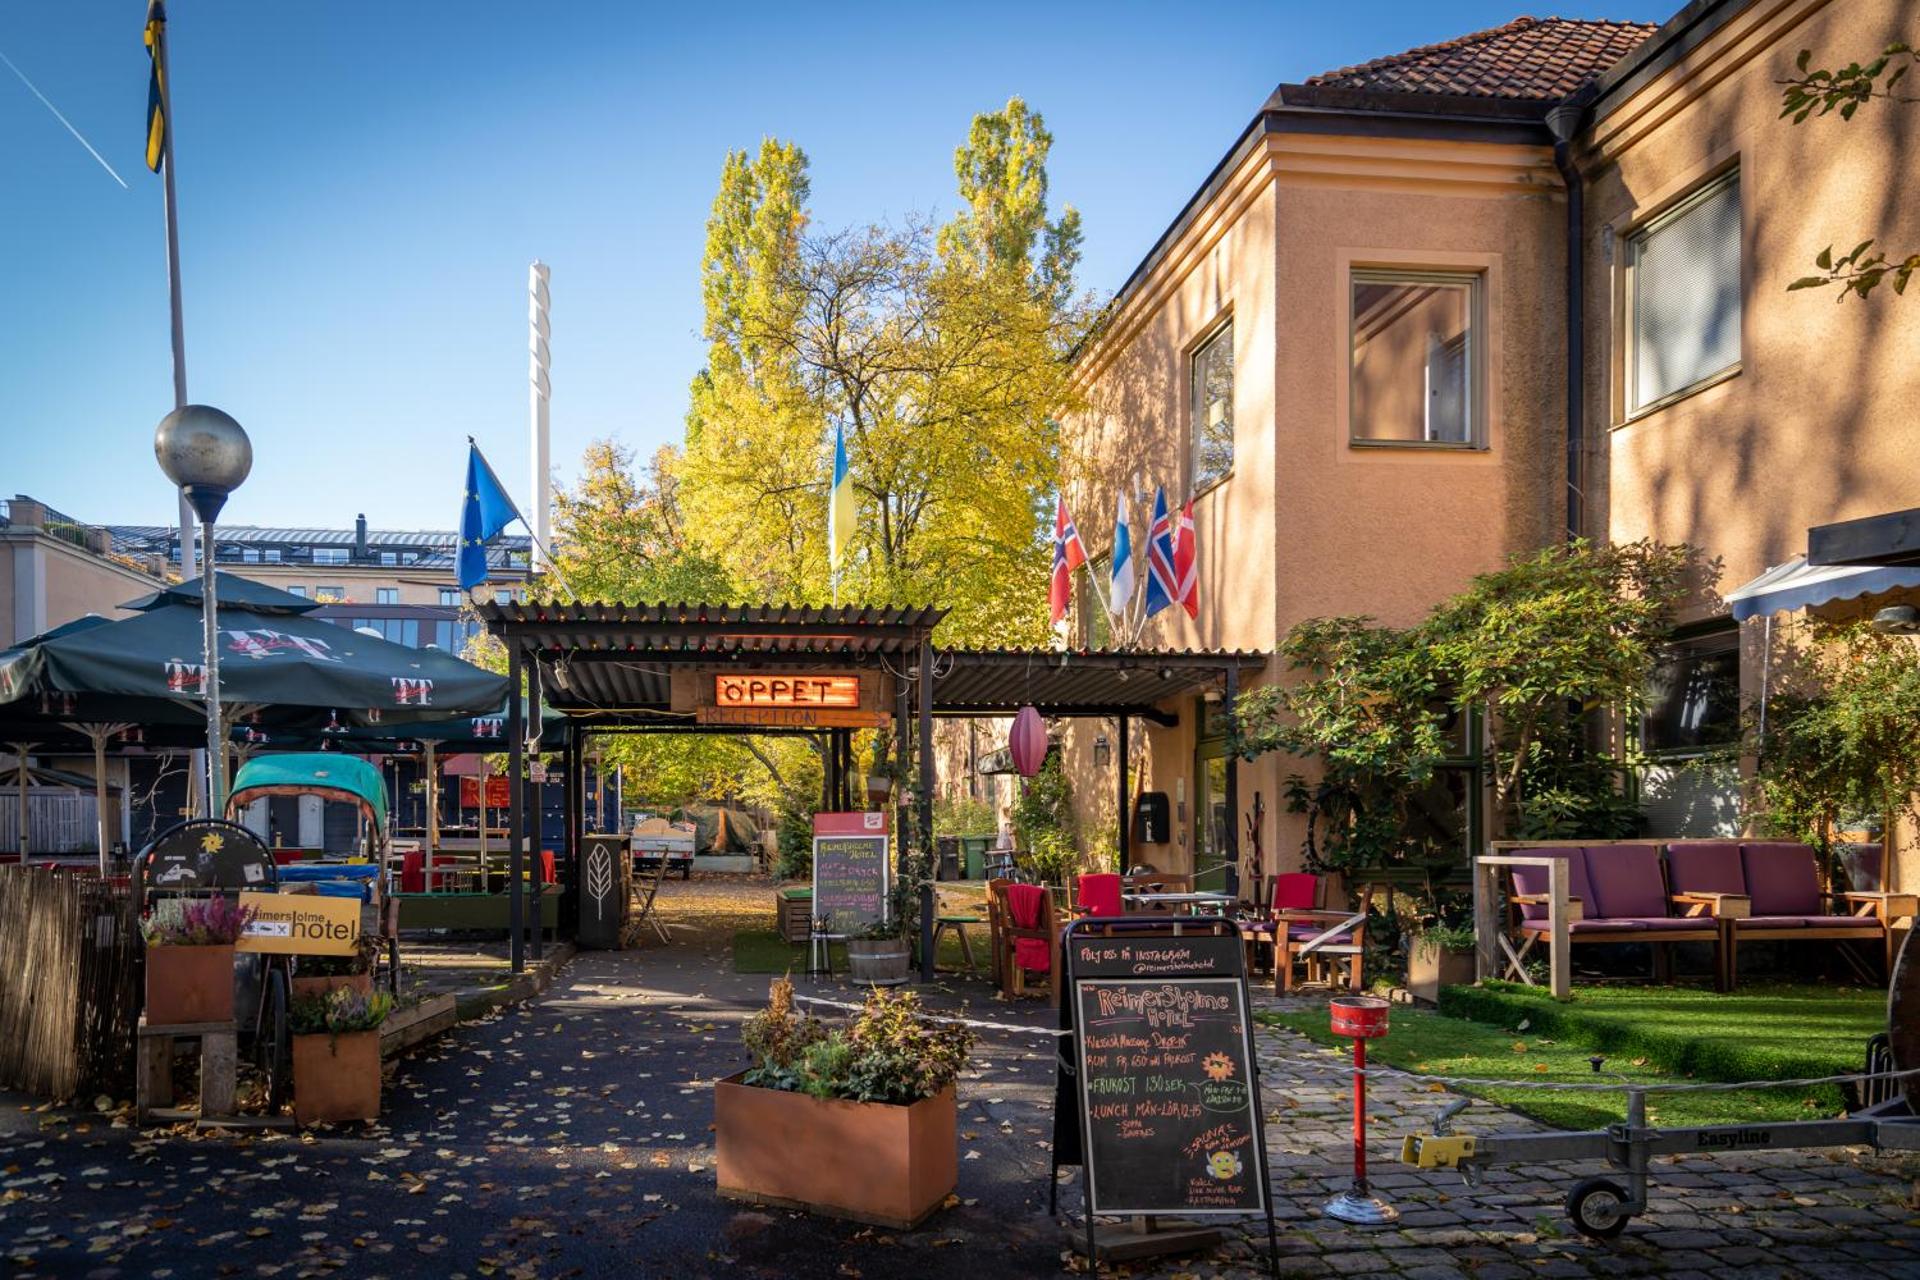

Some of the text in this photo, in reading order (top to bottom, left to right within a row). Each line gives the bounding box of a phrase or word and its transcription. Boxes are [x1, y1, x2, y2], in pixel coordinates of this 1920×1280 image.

[723, 680, 832, 703] ÖPPET
[705, 707, 817, 726] RECEPTION
[292, 911, 355, 940] hotel
[1135, 949, 1191, 963] INSTAGRAM
[1093, 1077, 1137, 1096] FRUKOST
[1094, 1102, 1128, 1119] LUNCH
[1697, 1128, 1770, 1148] Easyline
